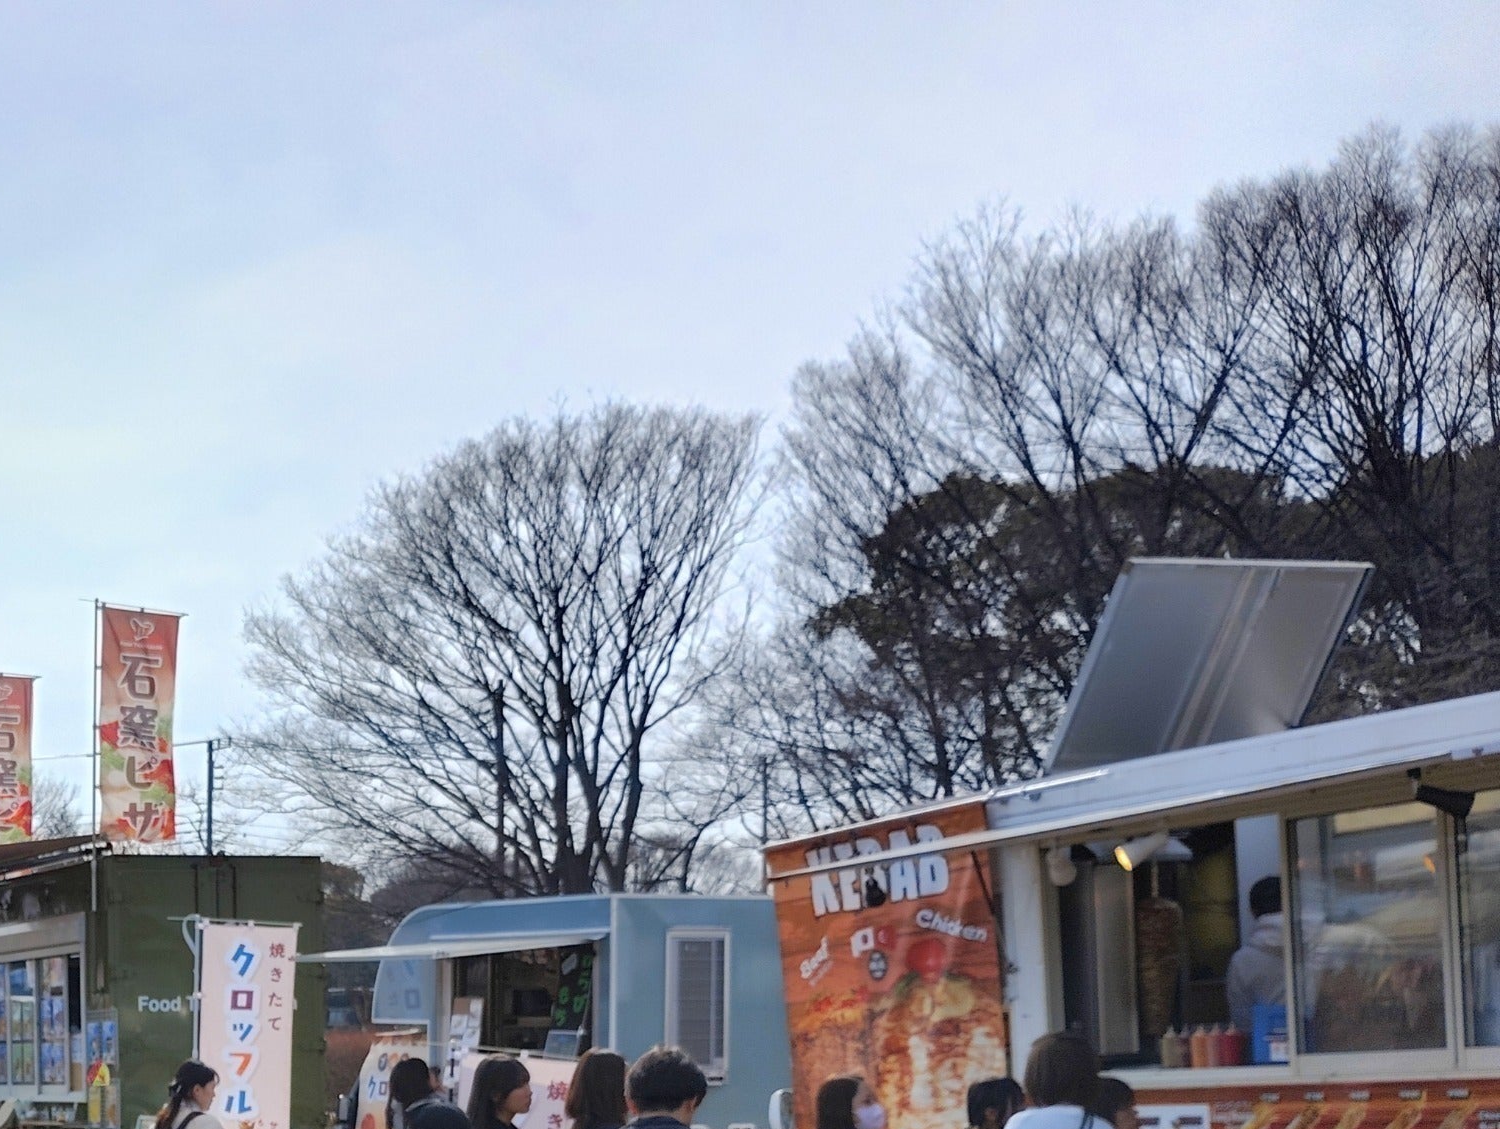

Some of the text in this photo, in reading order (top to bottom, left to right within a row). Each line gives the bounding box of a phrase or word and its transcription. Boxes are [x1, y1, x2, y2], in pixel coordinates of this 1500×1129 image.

[117, 652, 165, 842] 石窯ピザ
[915, 908, 988, 942] Chicken
[137, 995, 182, 1013] Food
[224, 943, 256, 1114] クロッフル
[267, 943, 287, 1031] 焼きたて
